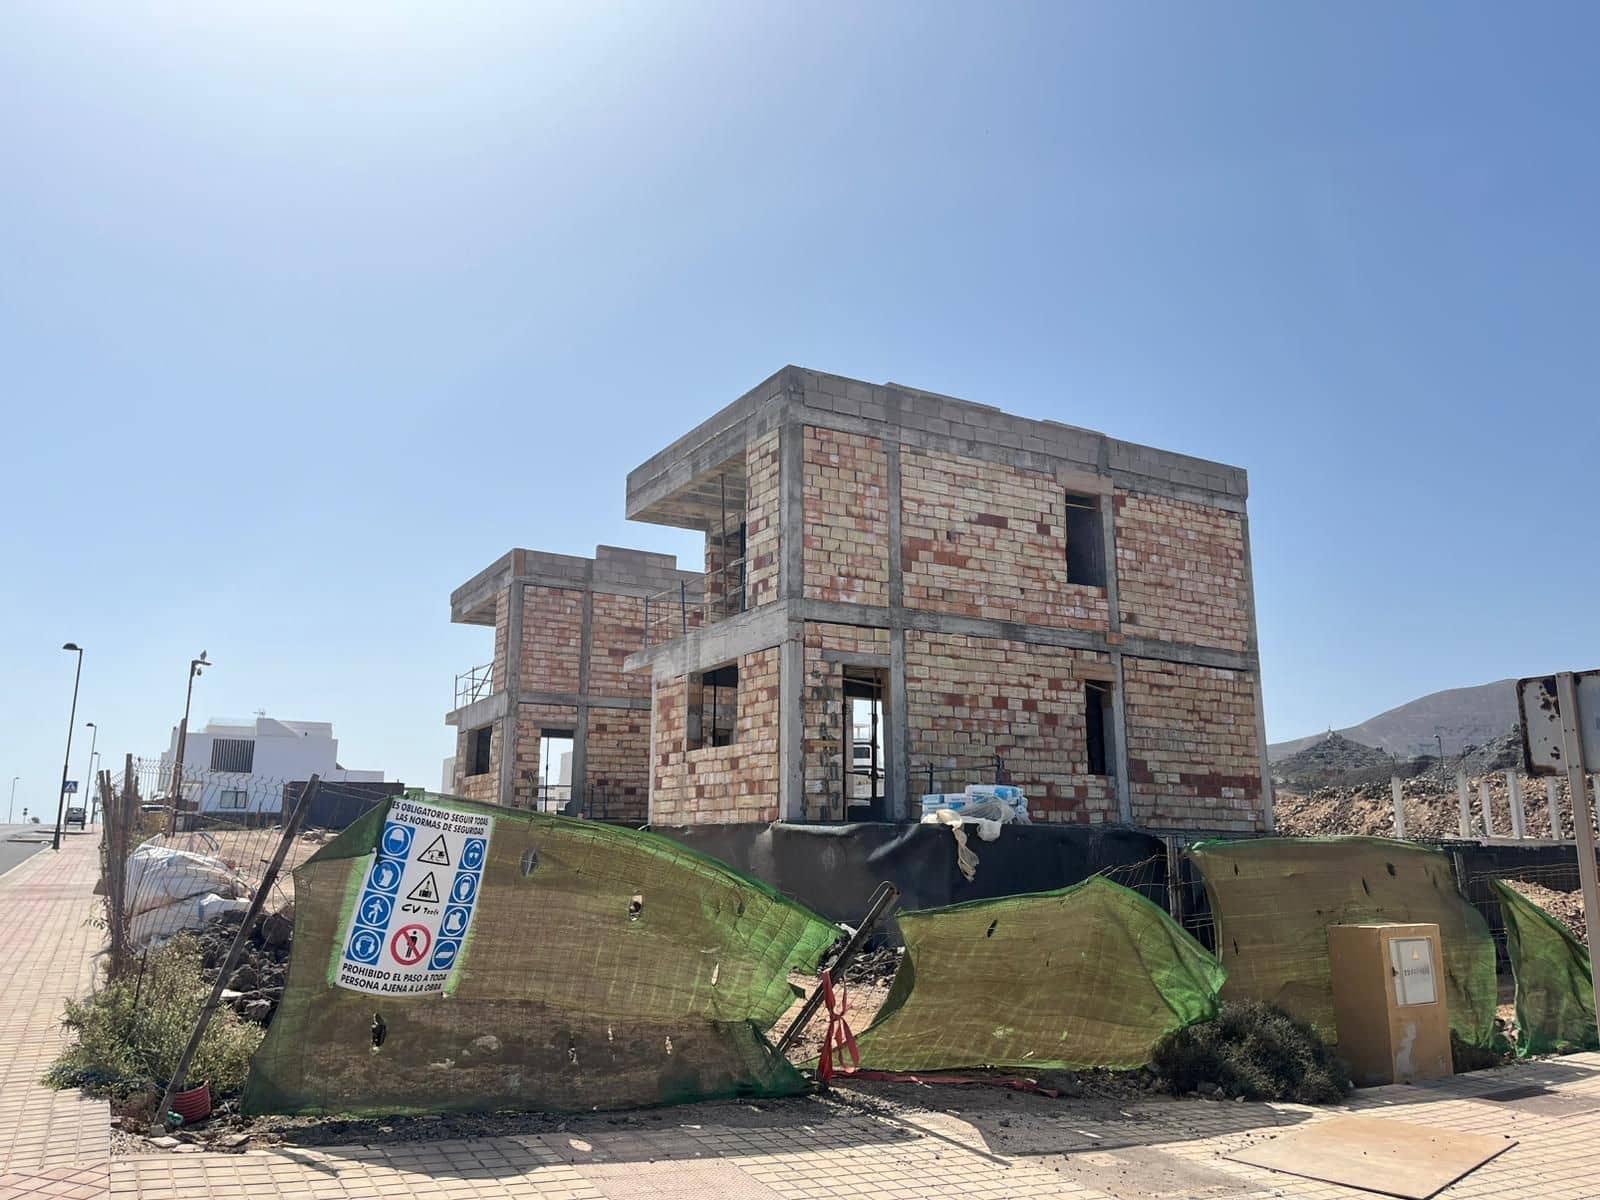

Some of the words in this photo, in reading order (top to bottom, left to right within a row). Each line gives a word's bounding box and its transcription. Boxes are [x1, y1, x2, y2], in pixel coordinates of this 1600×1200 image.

[391, 800, 401, 809] ES
[401, 802, 450, 820] OBLIGATORIO
[395, 812, 408, 822] LAS
[409, 815, 441, 830] NORMAS
[442, 822, 453, 832] DE
[453, 824, 485, 836] SEGURIDAD
[401, 903, 421, 914] CV
[342, 962, 391, 981] PROHIBIDO
[392, 972, 401, 982] EL
[402, 973, 423, 983] PASO
[422, 973, 430, 982] A
[429, 973, 448, 982] TODA
[340, 974, 380, 991] PERSONA
[381, 983, 408, 993] AJENA
[407, 984, 415, 993] A
[414, 983, 424, 993] LA
